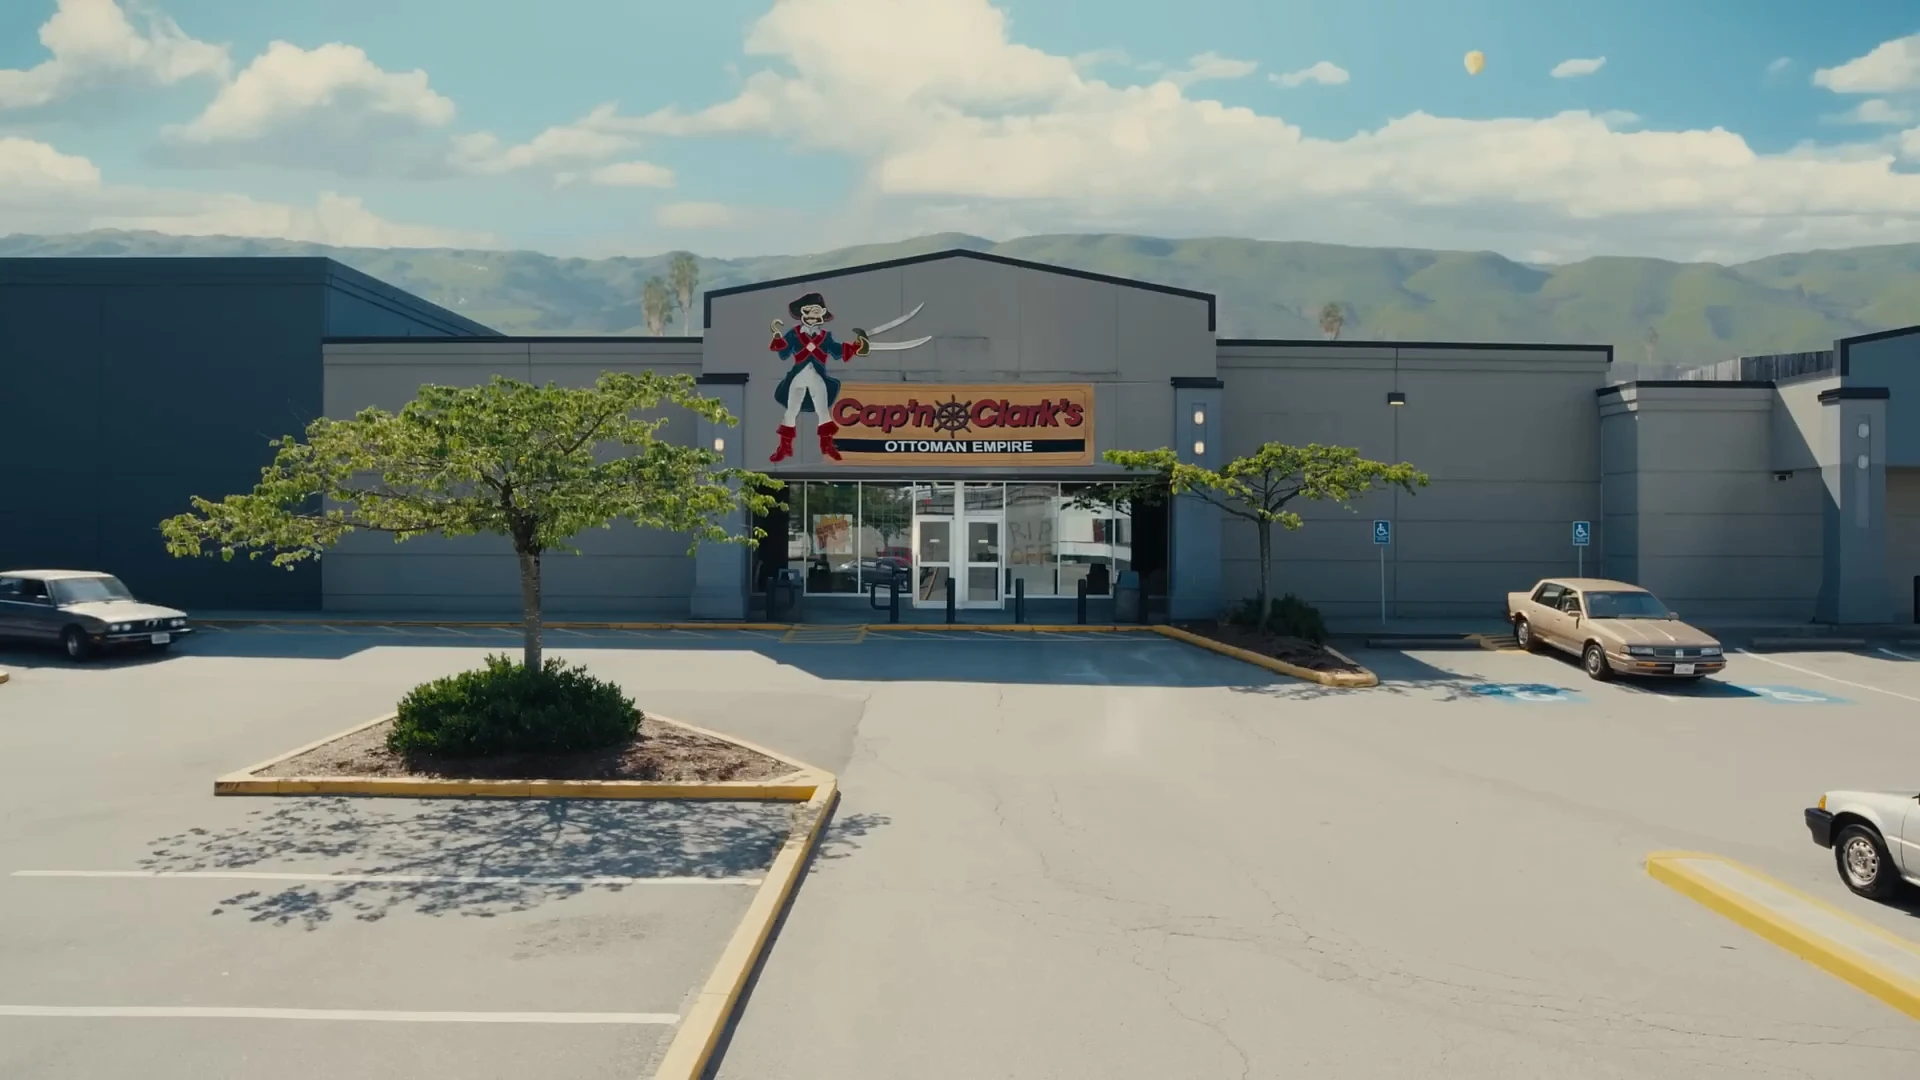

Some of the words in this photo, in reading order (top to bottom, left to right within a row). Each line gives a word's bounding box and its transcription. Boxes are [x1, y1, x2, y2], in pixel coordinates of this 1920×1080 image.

[832, 398, 935, 432] Cap'n
[970, 398, 1084, 427] Clark's
[884, 441, 967, 453] OTTOMAN
[973, 441, 1033, 453] EMPIRE
[1008, 520, 1052, 544] RIP
[1011, 544, 1052, 567] OFF
